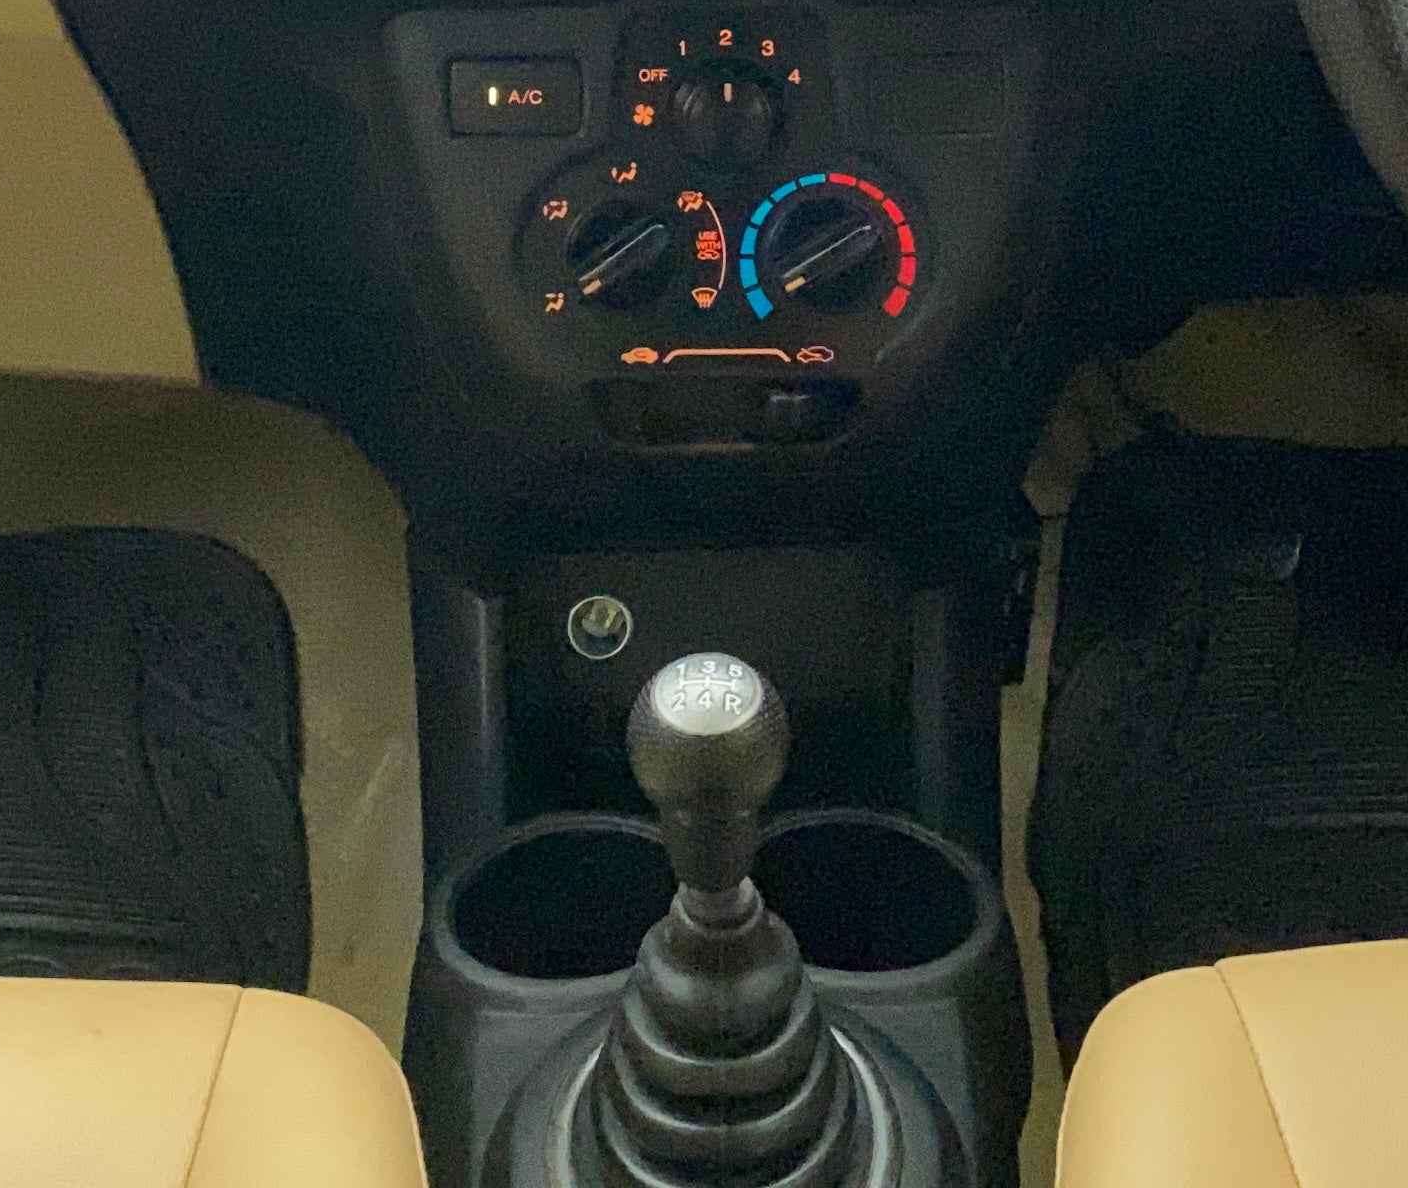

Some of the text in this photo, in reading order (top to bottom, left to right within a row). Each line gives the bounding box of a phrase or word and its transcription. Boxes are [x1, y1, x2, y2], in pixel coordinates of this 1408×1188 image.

[718, 29, 733, 46] 2
[679, 40, 687, 56] 1
[760, 39, 775, 57] 3
[638, 68, 669, 83] OFF
[787, 69, 802, 85] 4
[507, 89, 543, 105] A/C
[695, 240, 722, 250] WITH
[676, 661, 742, 677] 1 3 5
[671, 690, 742, 715] 2 4 R
